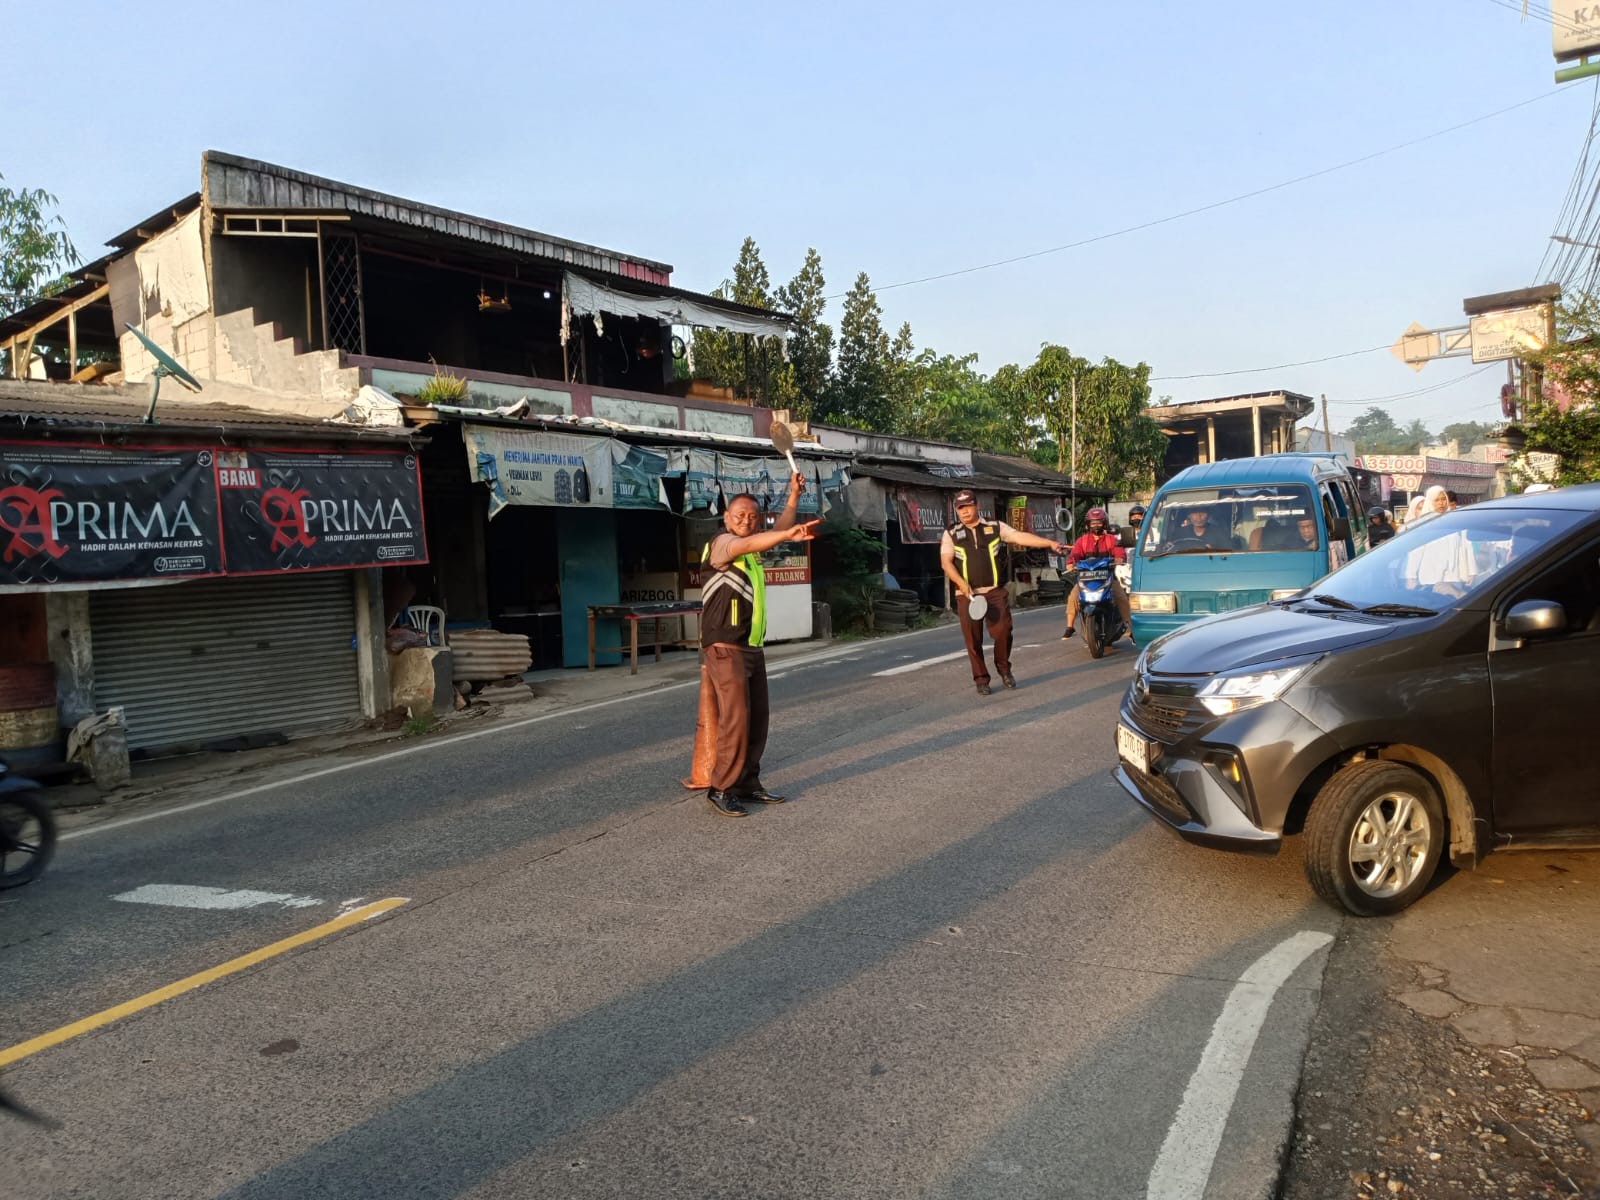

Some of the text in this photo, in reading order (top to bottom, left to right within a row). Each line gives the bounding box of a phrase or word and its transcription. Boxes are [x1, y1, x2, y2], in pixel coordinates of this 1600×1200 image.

[1367, 458, 1425, 469] 35.000
[219, 470, 257, 486] BARU
[50, 500, 203, 541] PRIMA
[301, 498, 412, 533] PRIMA
[917, 508, 944, 526] PRIMA
[81, 540, 203, 552] HADIR DALAM KEMASAN KERTAS
[775, 571, 806, 582] PADANG
